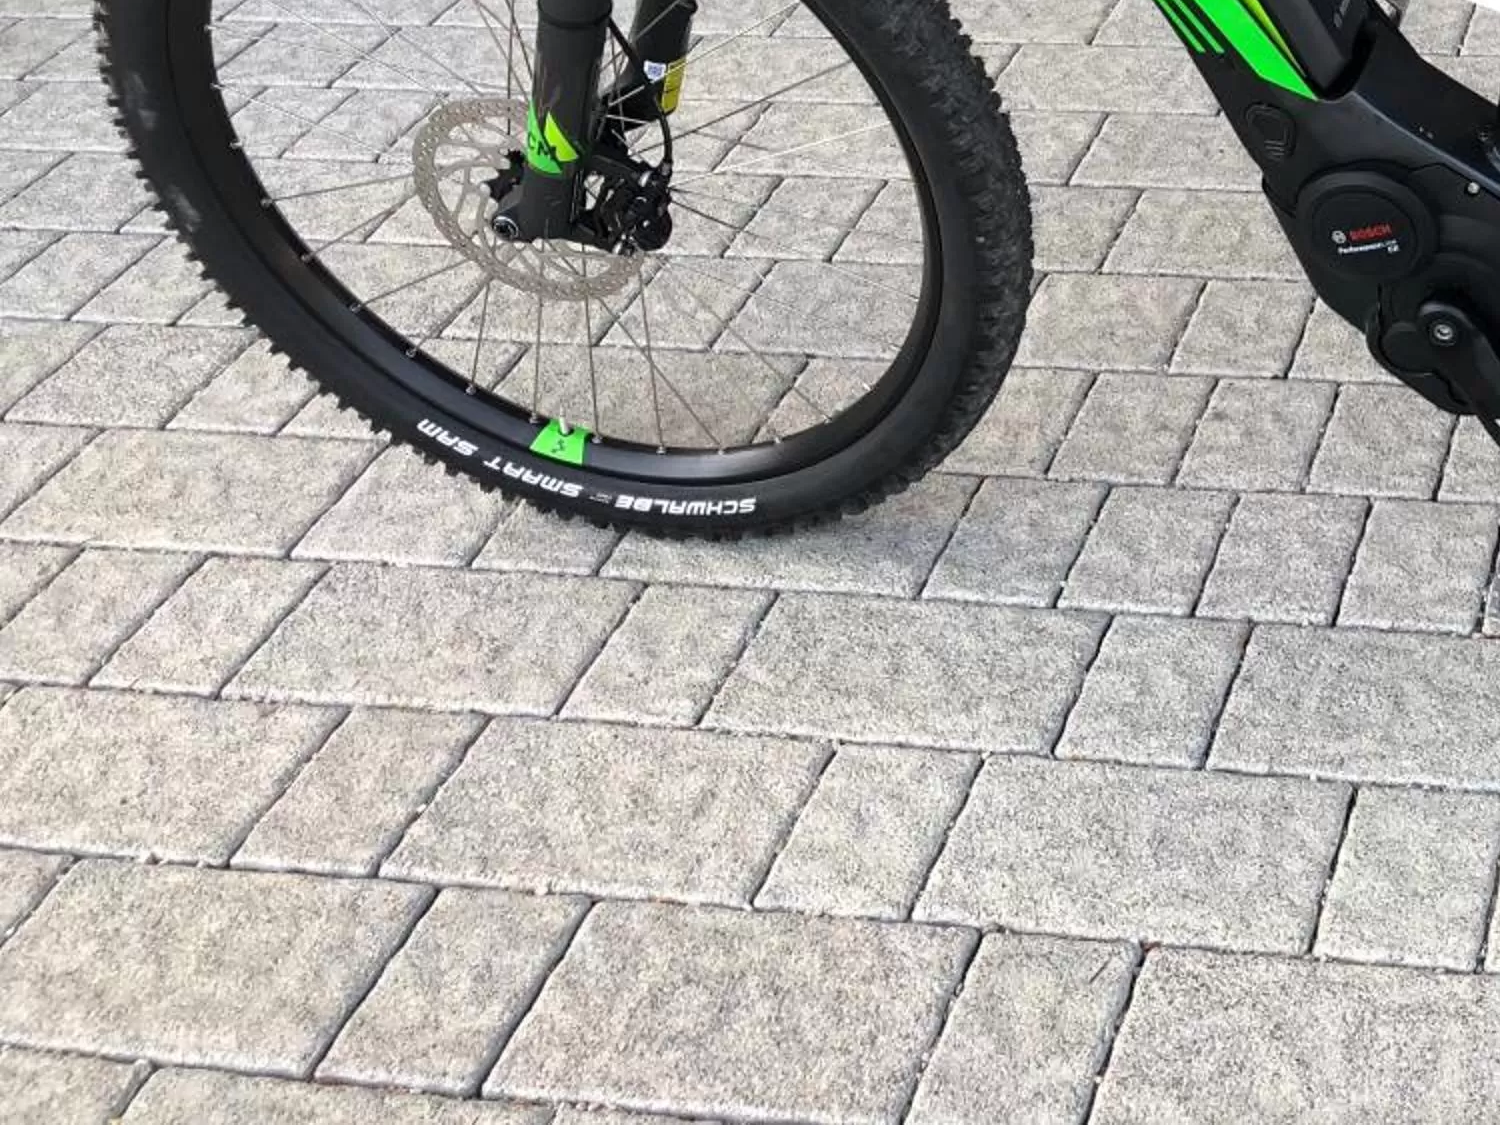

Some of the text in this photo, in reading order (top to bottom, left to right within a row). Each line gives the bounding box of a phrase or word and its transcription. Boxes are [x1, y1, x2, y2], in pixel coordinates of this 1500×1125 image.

[1349, 223, 1392, 241] BOSCH
[415, 417, 757, 517] SCHWALBE SMART SAM
